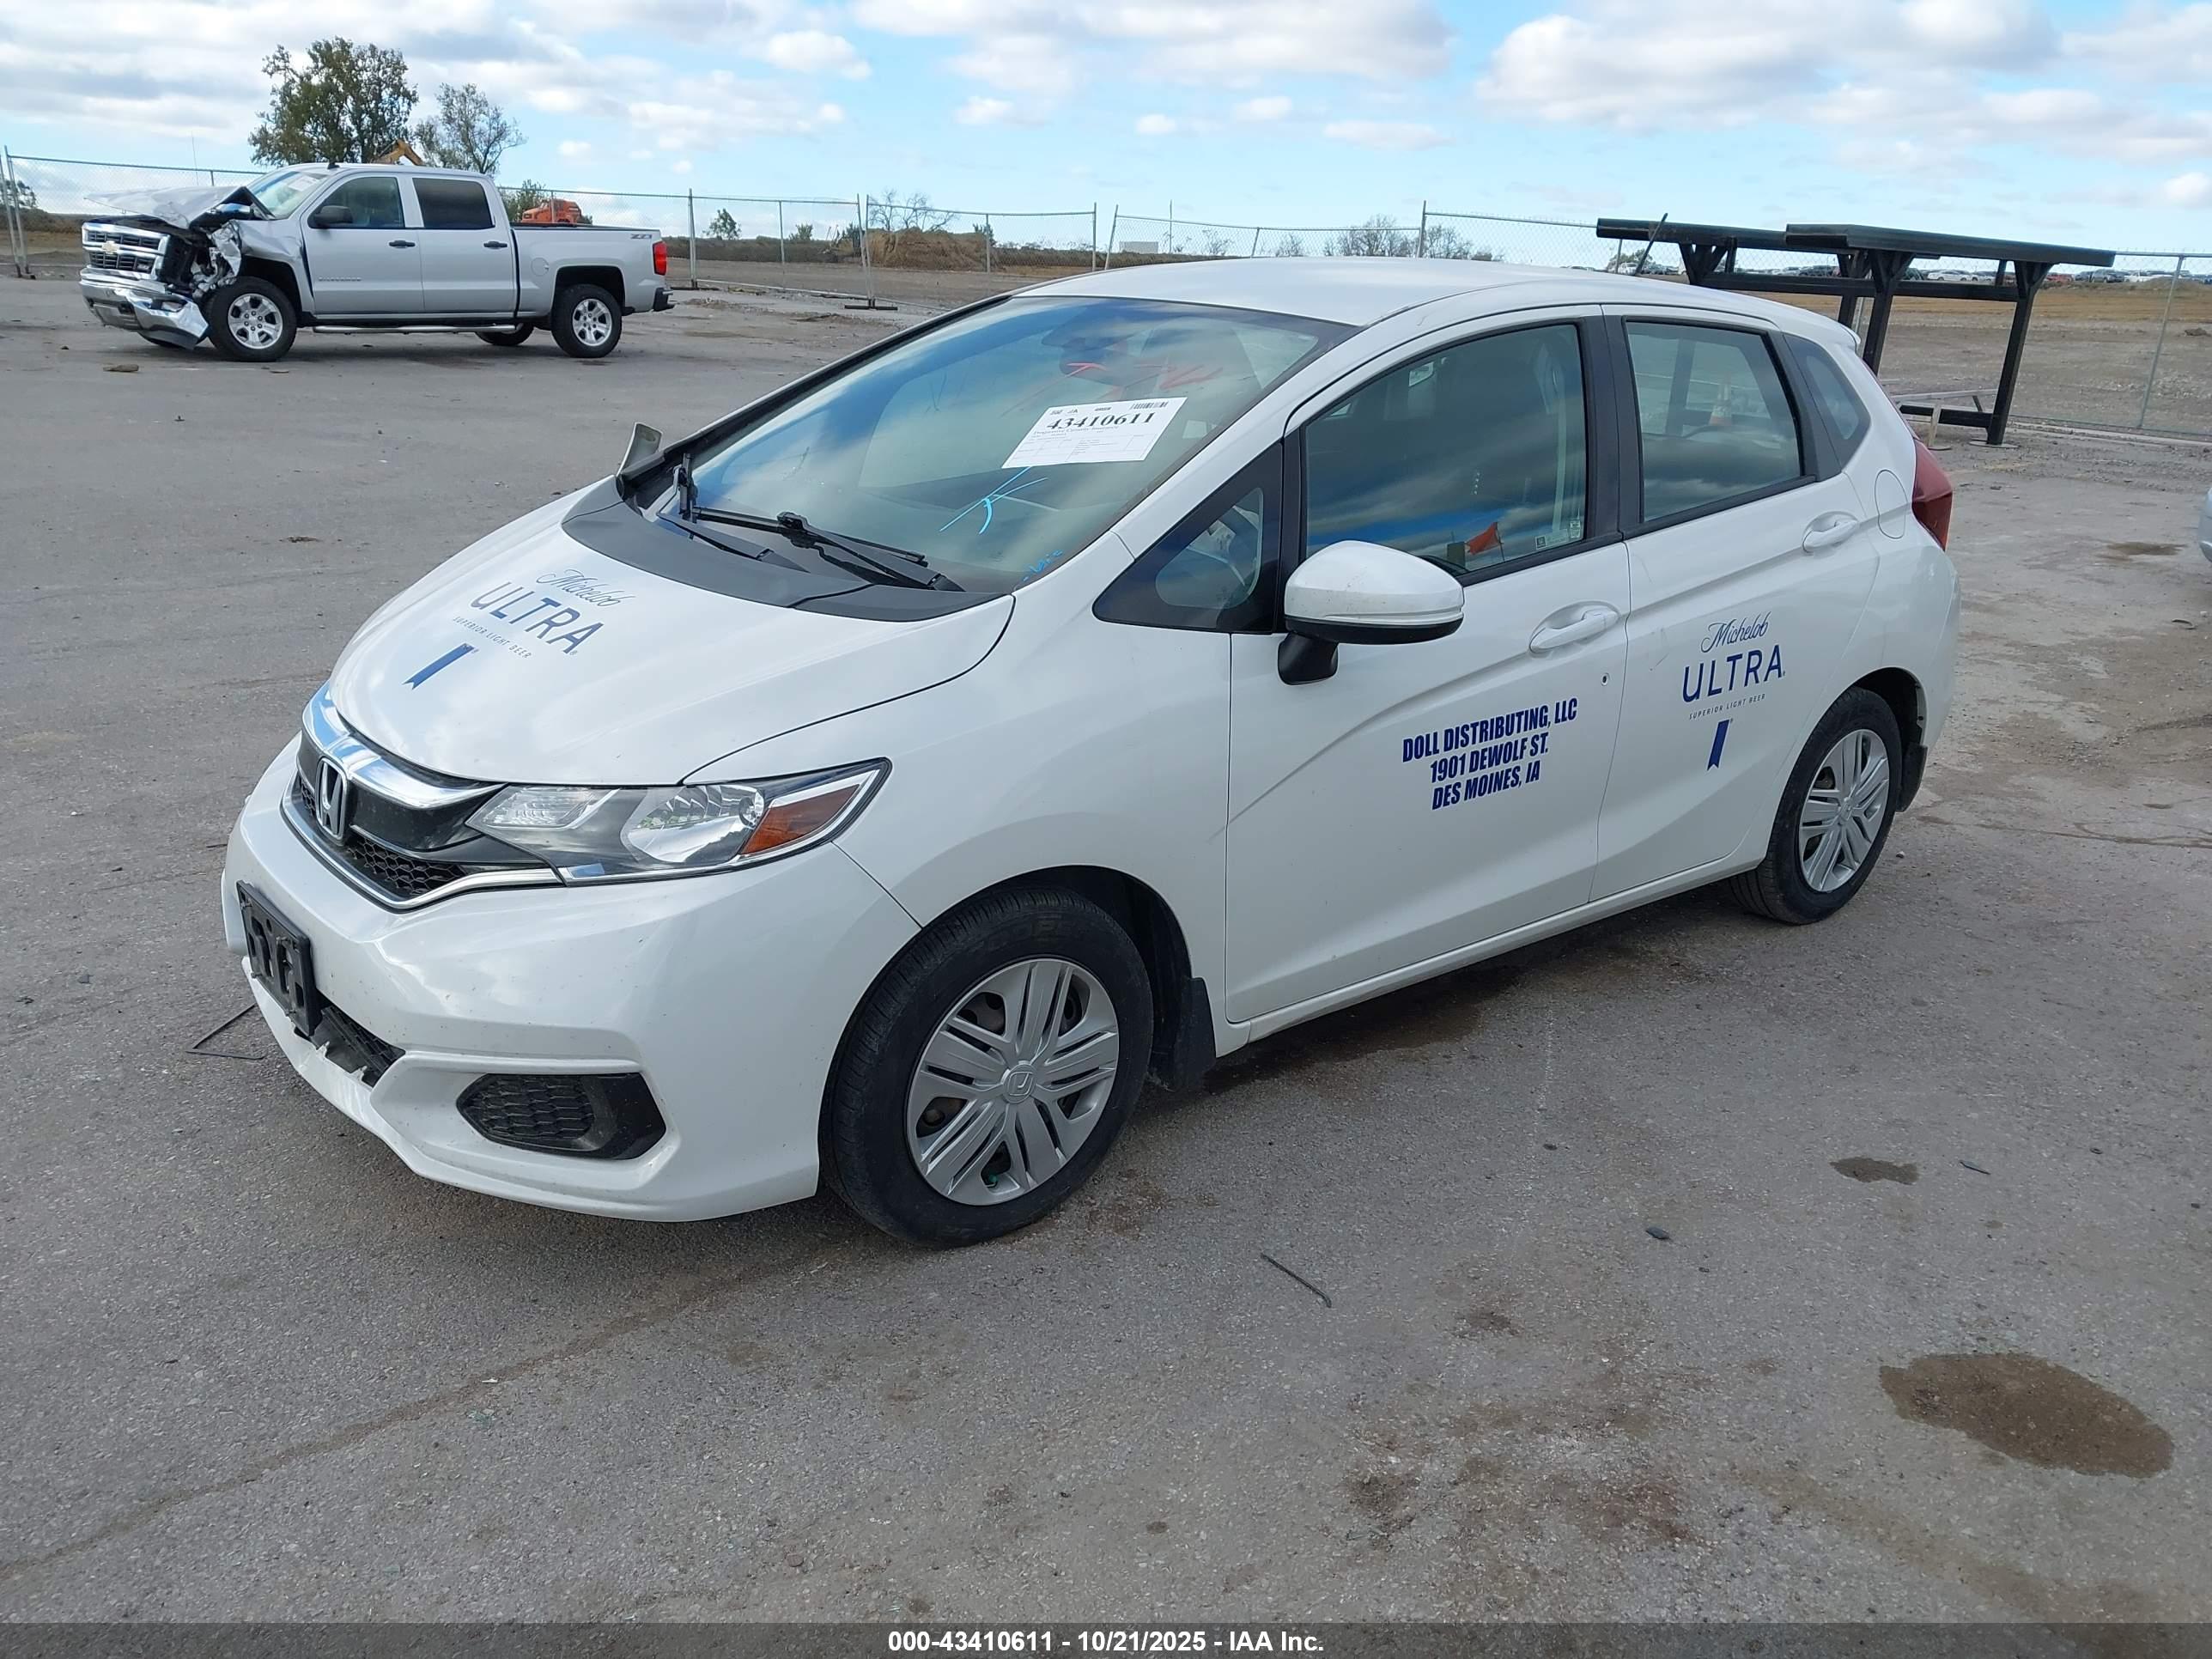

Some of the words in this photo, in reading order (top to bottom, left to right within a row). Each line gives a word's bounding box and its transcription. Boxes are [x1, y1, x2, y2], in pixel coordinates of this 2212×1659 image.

[1047, 411, 1156, 429] 43410611
[536, 568, 636, 607] Michelob
[453, 616, 488, 635] SUPERIOR
[486, 632, 510, 646] LIGHT
[509, 645, 532, 659] BEER
[471, 581, 605, 654] ULTRA
[1700, 611, 1771, 653] Michelob
[1683, 644, 1783, 703] ULTRA
[1402, 732, 1440, 763] DOLL
[1443, 704, 1552, 752] DISTRIBUTING,
[1554, 697, 1578, 724] LLC
[1689, 705, 1723, 720] SUPERIOR
[1726, 698, 1747, 710] LIGHT
[1748, 693, 1765, 704] BEER
[1430, 752, 1467, 783] 1901
[1468, 737, 1528, 774] DEWOLF
[1529, 732, 1549, 757] ST.
[1431, 781, 1462, 811] DES
[1463, 765, 1522, 801] MOINES,
[1525, 760, 1540, 784] IA
